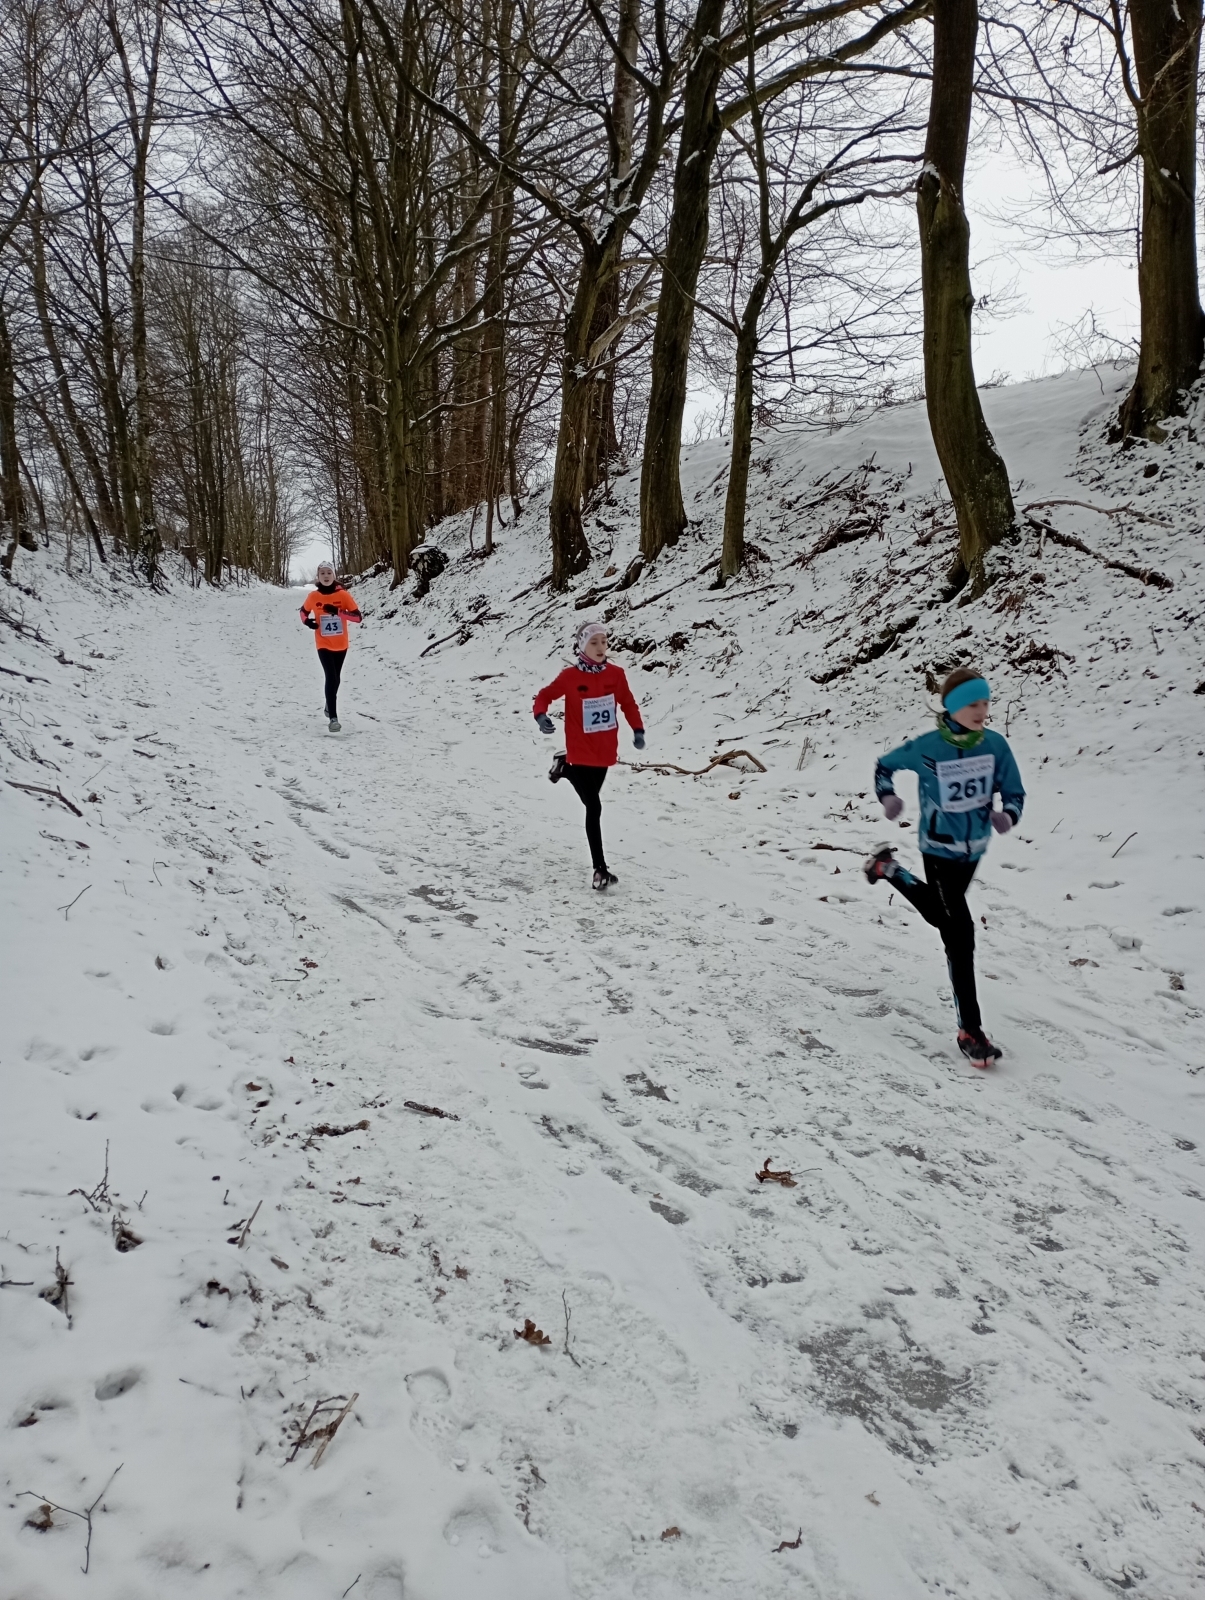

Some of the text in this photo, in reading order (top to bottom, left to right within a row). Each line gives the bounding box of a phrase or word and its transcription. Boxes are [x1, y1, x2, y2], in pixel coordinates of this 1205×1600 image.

[325, 622, 338, 631] 43
[591, 709, 610, 725] 29
[947, 776, 986, 801] 261
